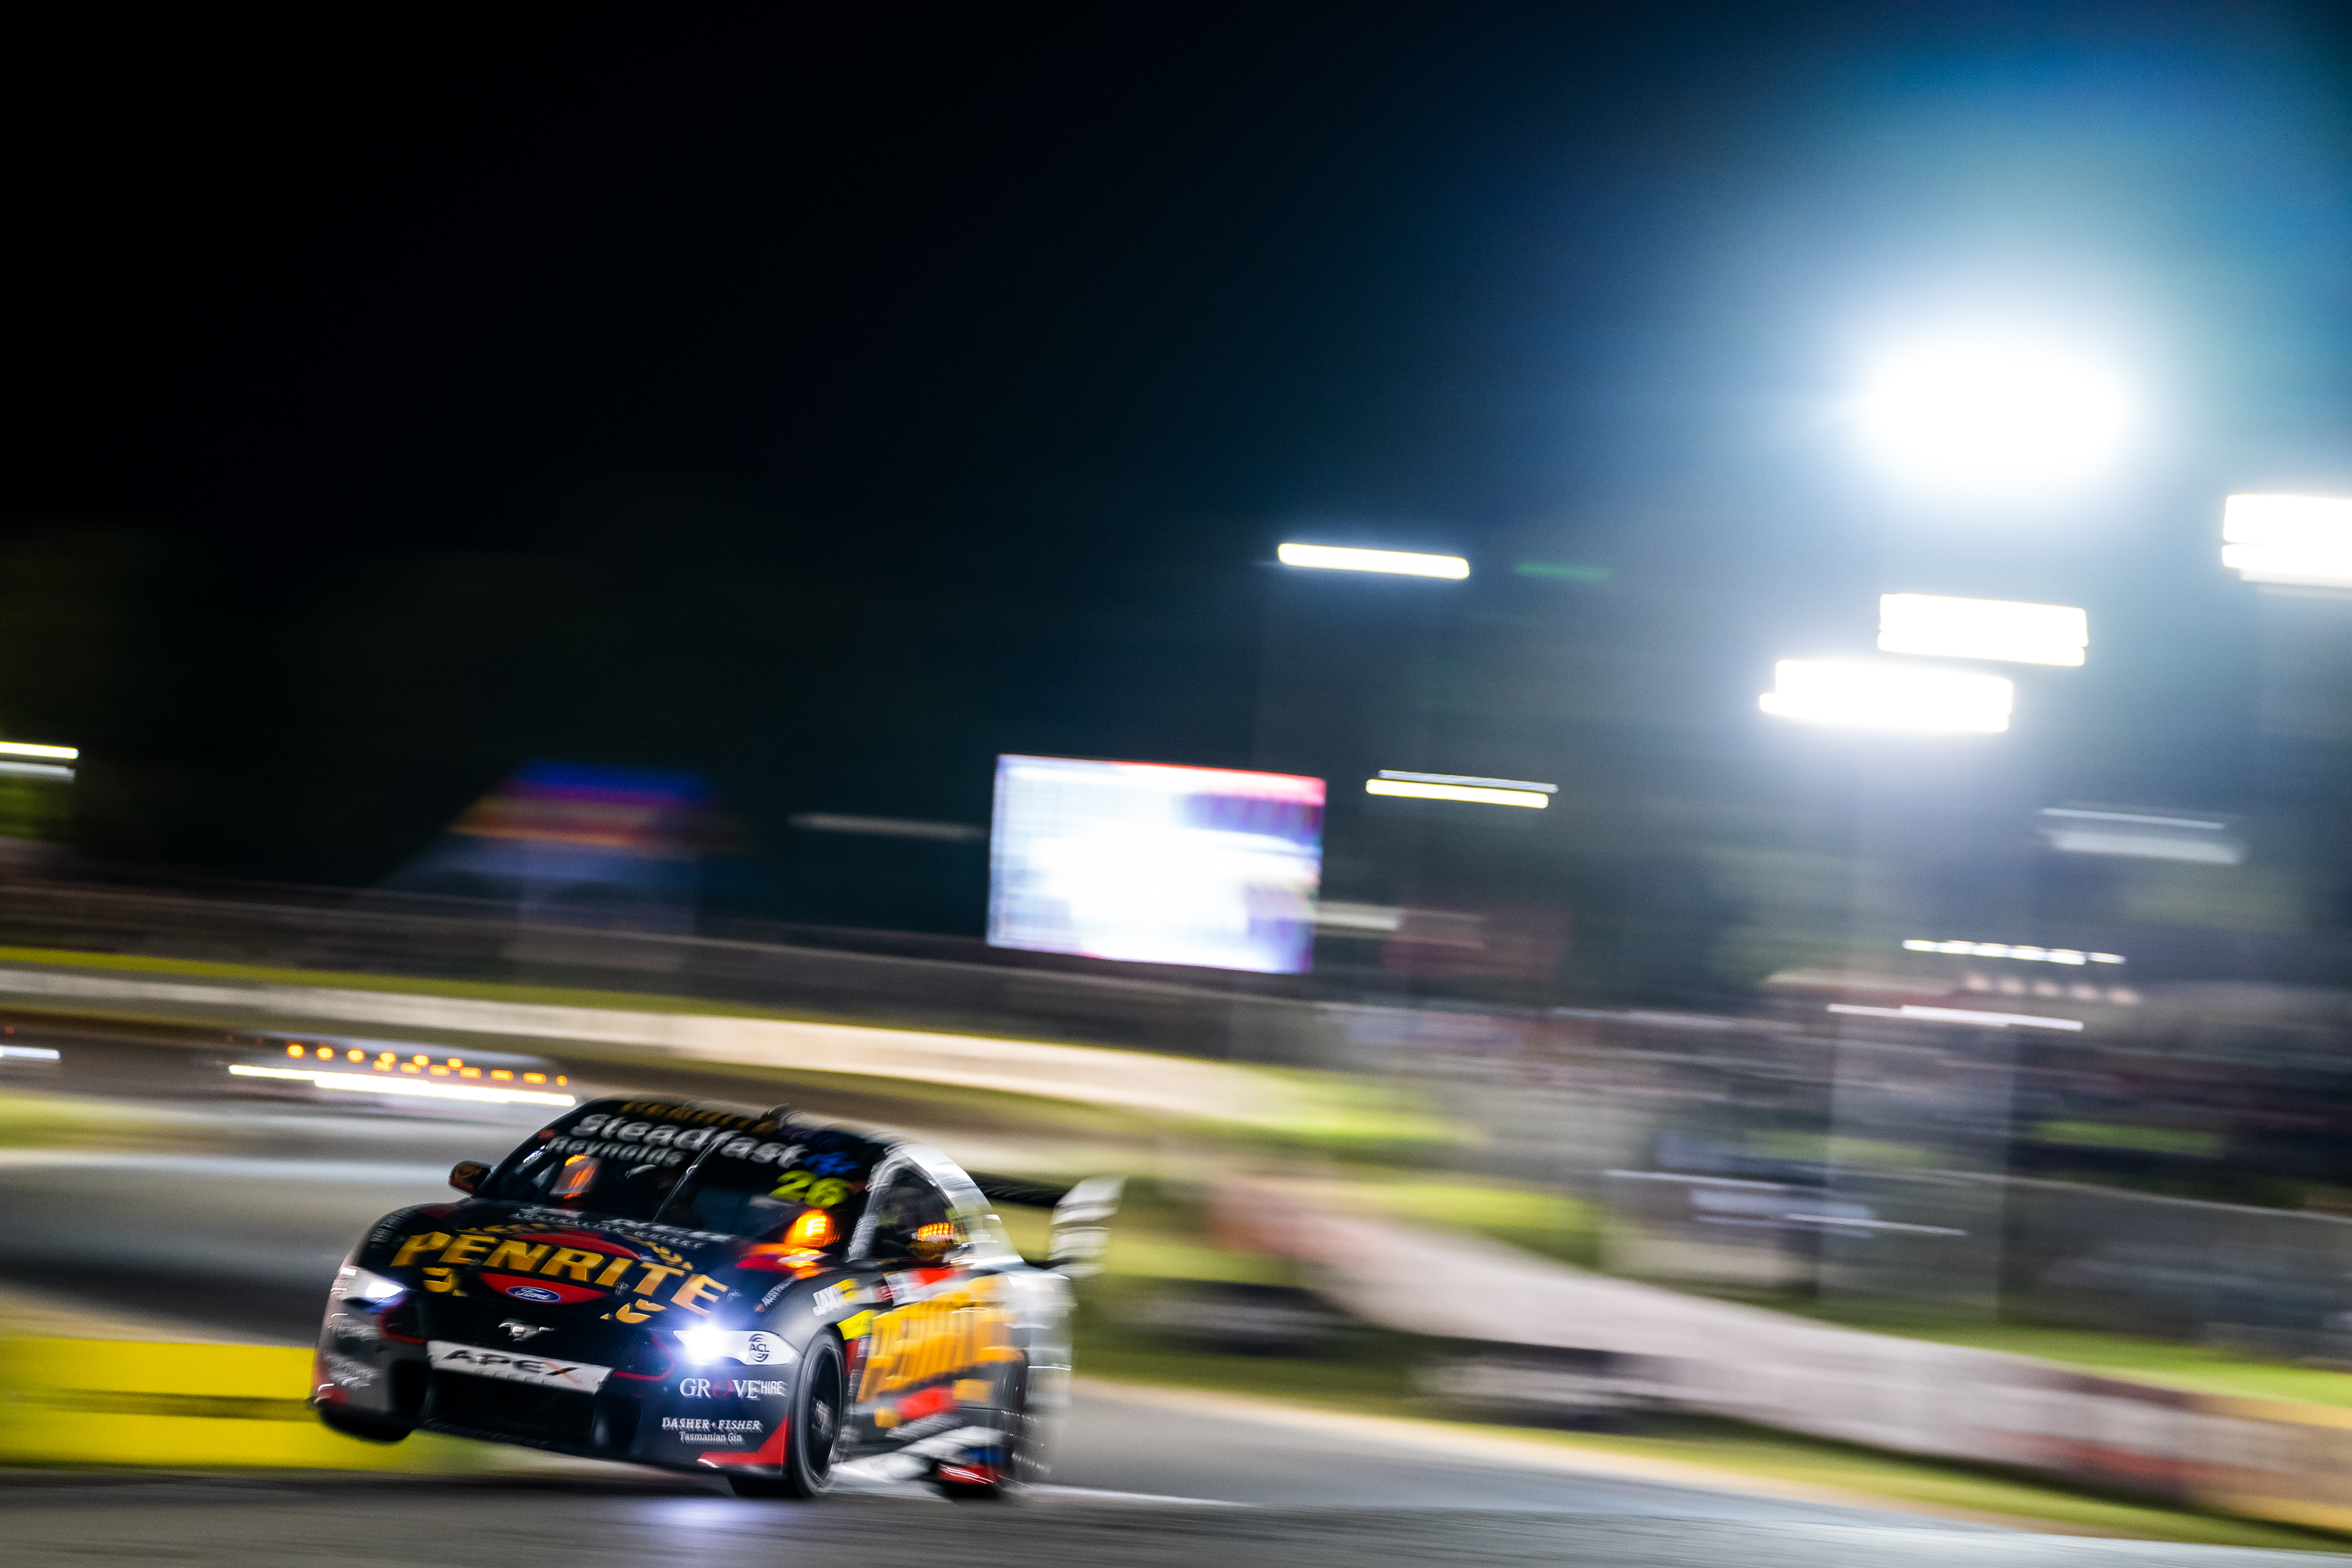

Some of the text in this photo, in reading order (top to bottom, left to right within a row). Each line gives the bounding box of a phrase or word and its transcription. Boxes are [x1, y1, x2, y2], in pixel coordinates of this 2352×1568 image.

[545, 1135, 689, 1168] Reynolds
[570, 1113, 810, 1169] Steadfast
[769, 1170, 849, 1209] 26
[390, 1231, 730, 1317] PENRITE
[515, 1287, 551, 1300] Ford
[748, 1343, 770, 1353] ACL
[443, 1349, 583, 1385] APEX
[680, 1378, 787, 1400] GROVE HIRE
[661, 1417, 763, 1433] DASHER FISHER
[679, 1431, 746, 1446] Tasmanian Gin
